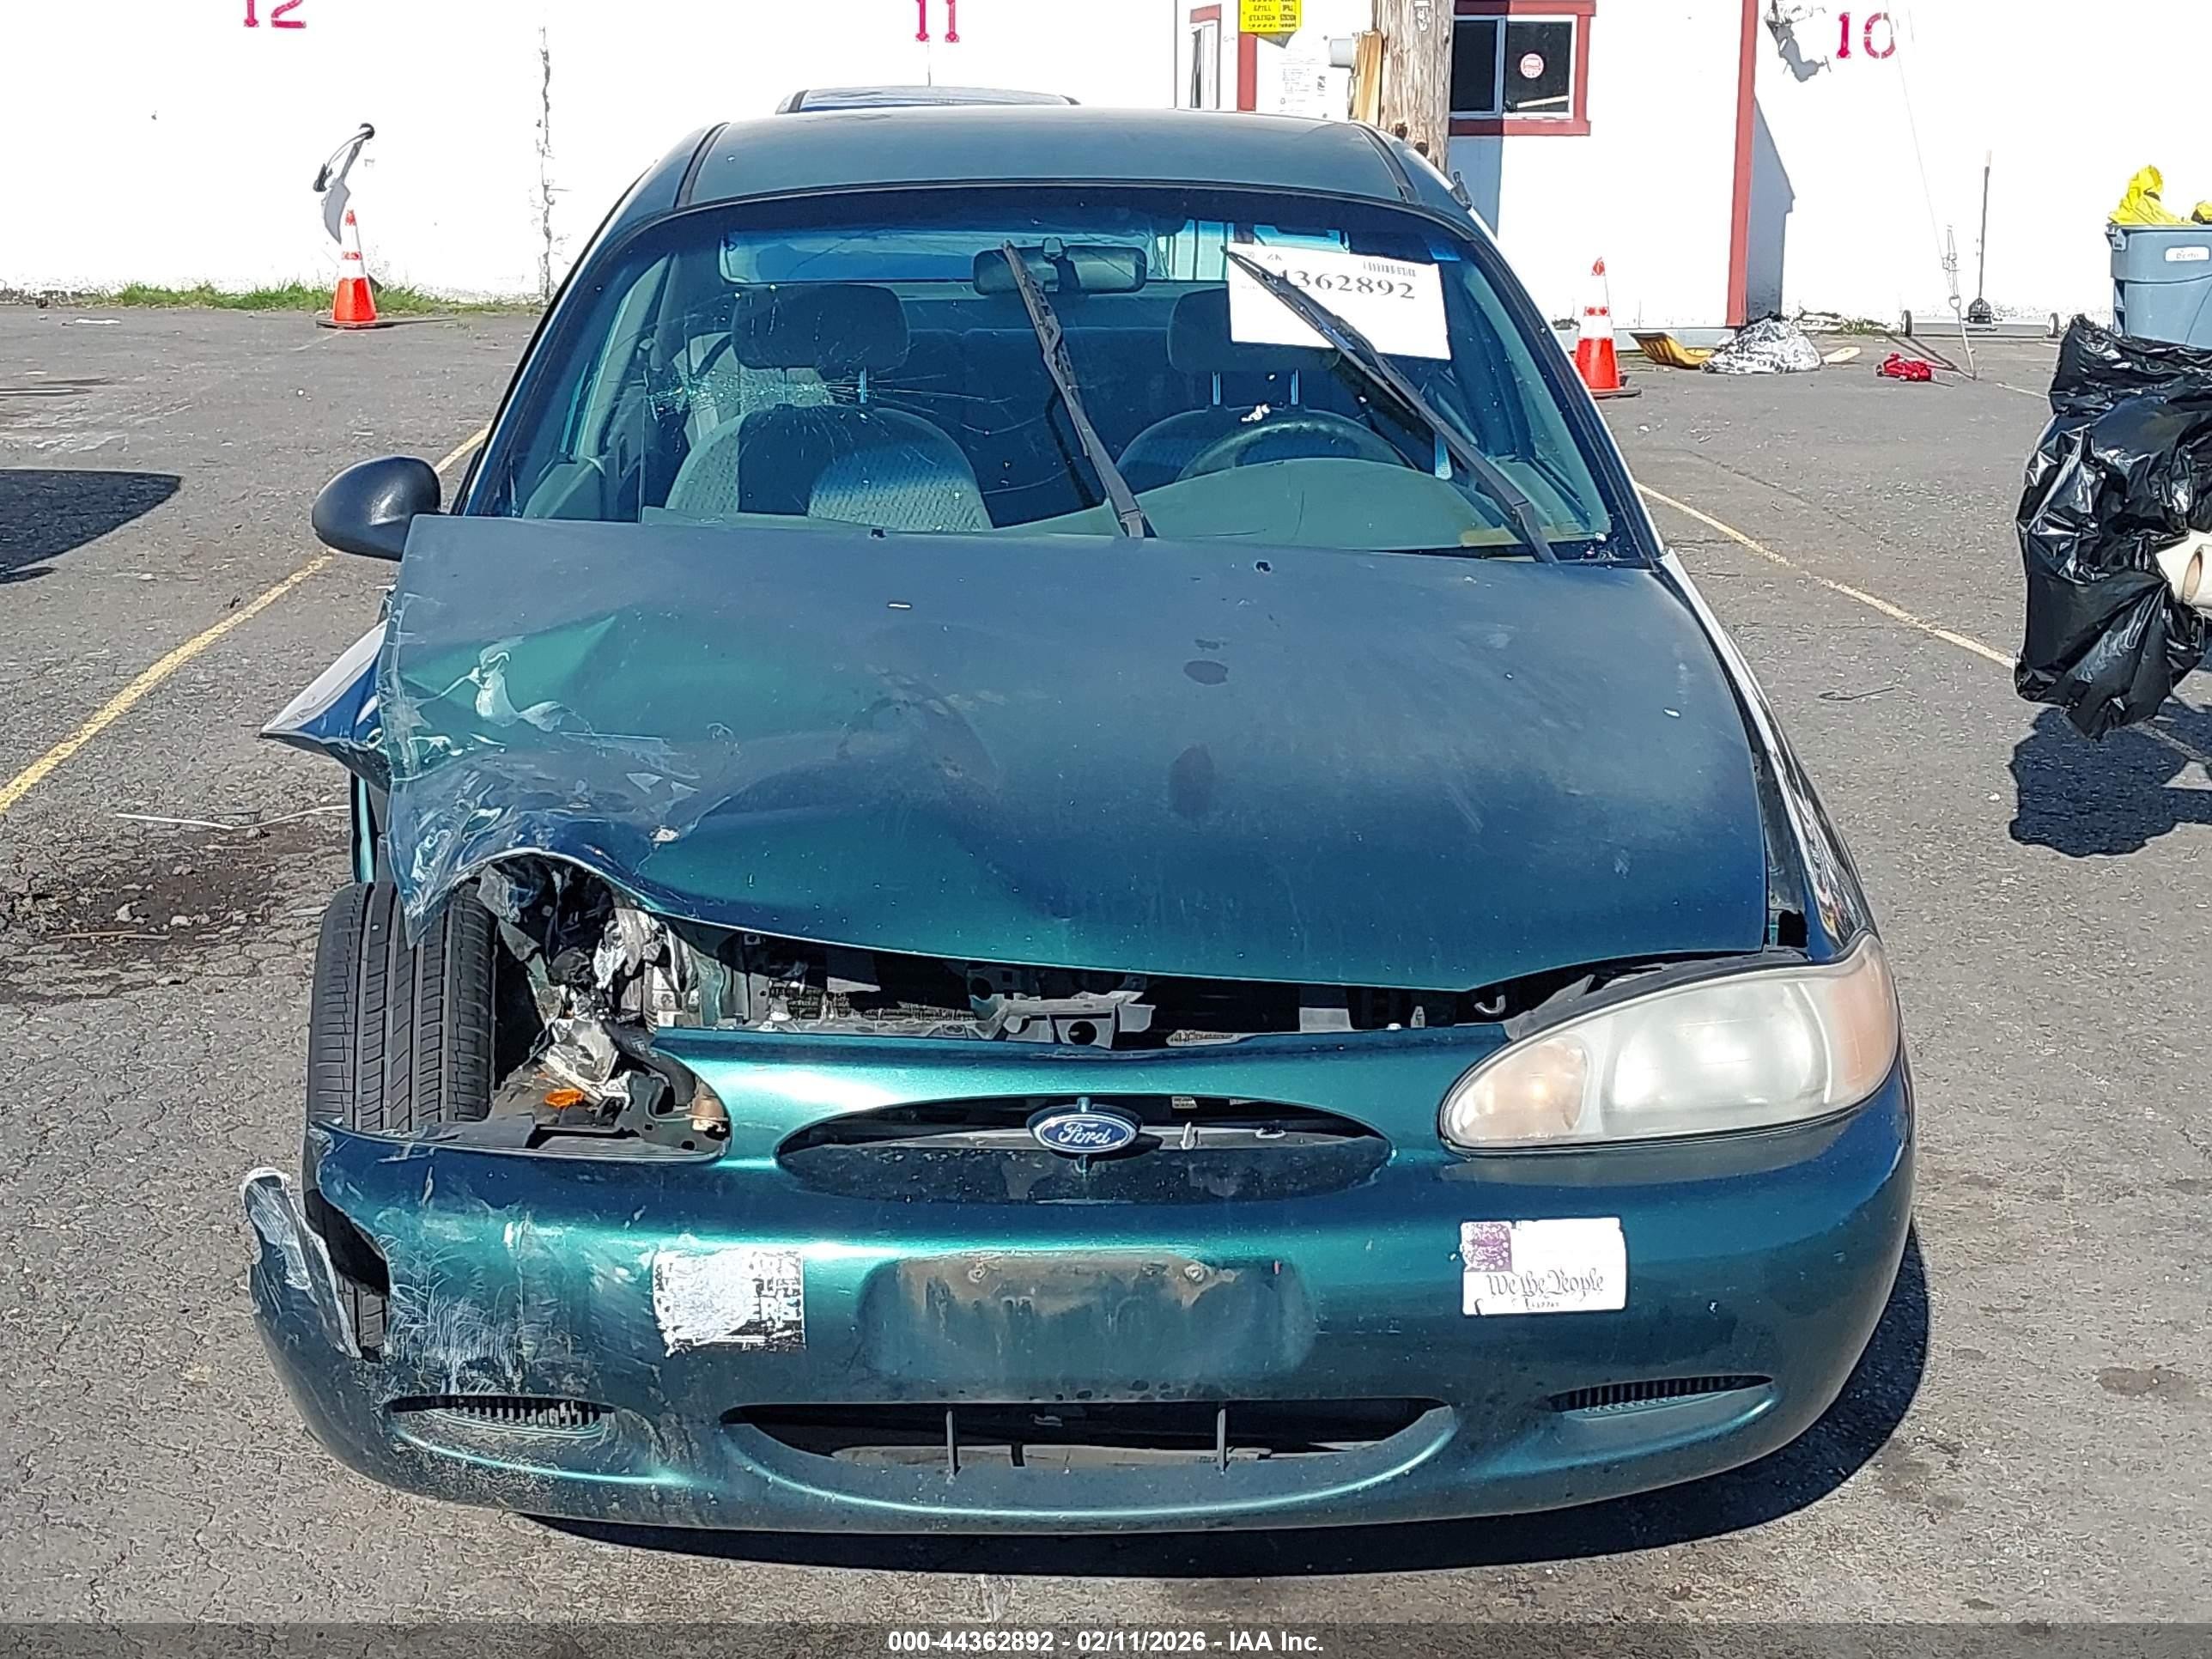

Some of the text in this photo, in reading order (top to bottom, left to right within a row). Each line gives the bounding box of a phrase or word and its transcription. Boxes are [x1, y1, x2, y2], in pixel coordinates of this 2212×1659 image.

[243, 0, 307, 28] 12
[915, 0, 960, 42] 11
[1836, 12, 1896, 59] 10
[1058, 1121, 1112, 1144] Ford
[1486, 1273, 1517, 1297] We
[1545, 1267, 1604, 1302] People
